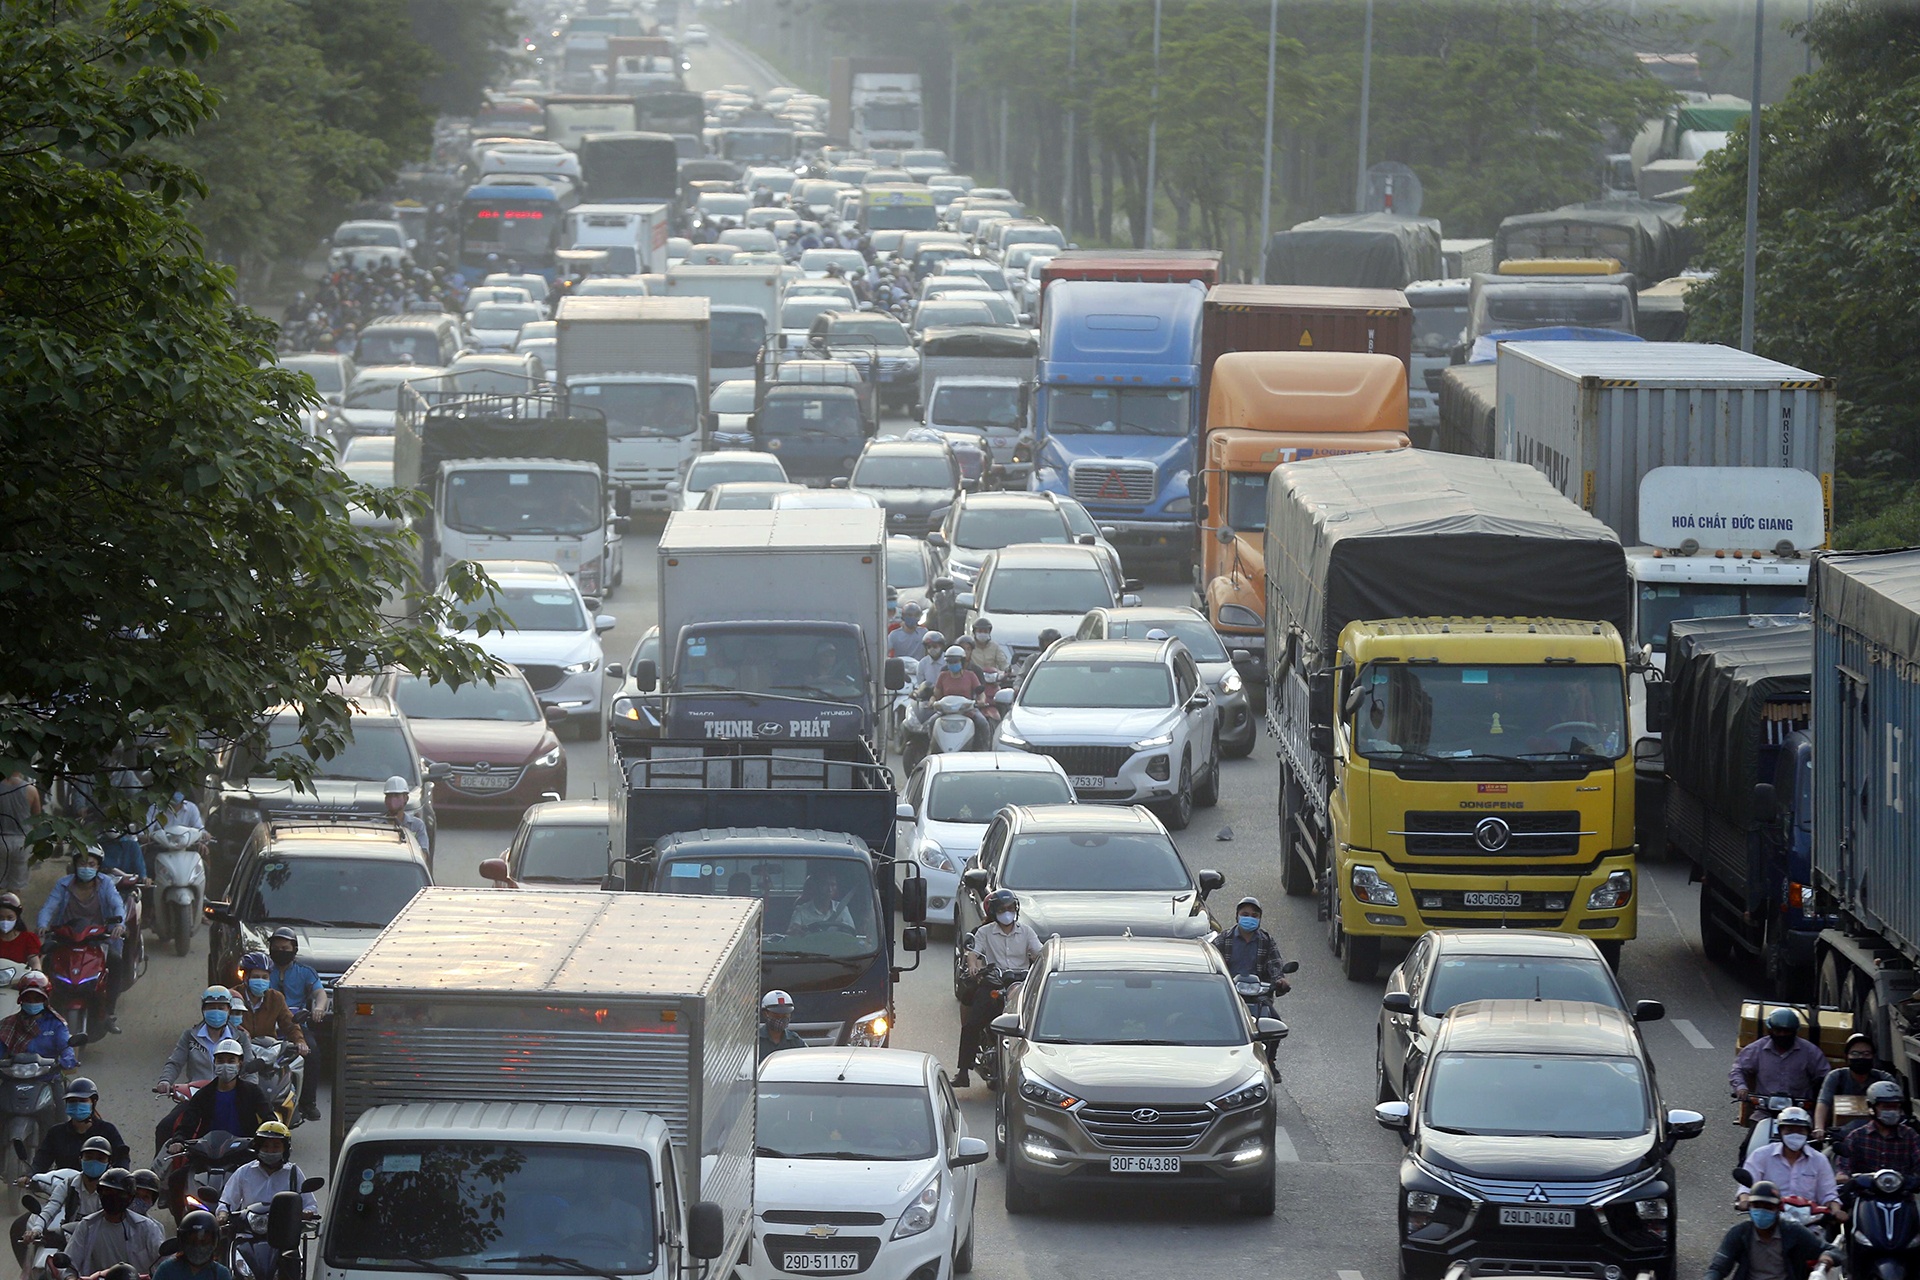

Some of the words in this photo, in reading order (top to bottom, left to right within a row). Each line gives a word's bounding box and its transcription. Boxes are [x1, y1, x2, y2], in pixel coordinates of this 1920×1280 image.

[1698, 512, 1727, 529] CHẤT
[1731, 513, 1755, 530] ĐỨC
[1758, 518, 1793, 531] GIANG
[789, 717, 831, 738] PHÁT
[1459, 801, 1524, 809] DONGFENG
[1466, 893, 1520, 906] 43C-056.52
[1112, 1157, 1178, 1171] 30F-643.88
[1503, 1210, 1571, 1225] 29LD-048.40
[785, 1254, 856, 1269] 29D-511.67
